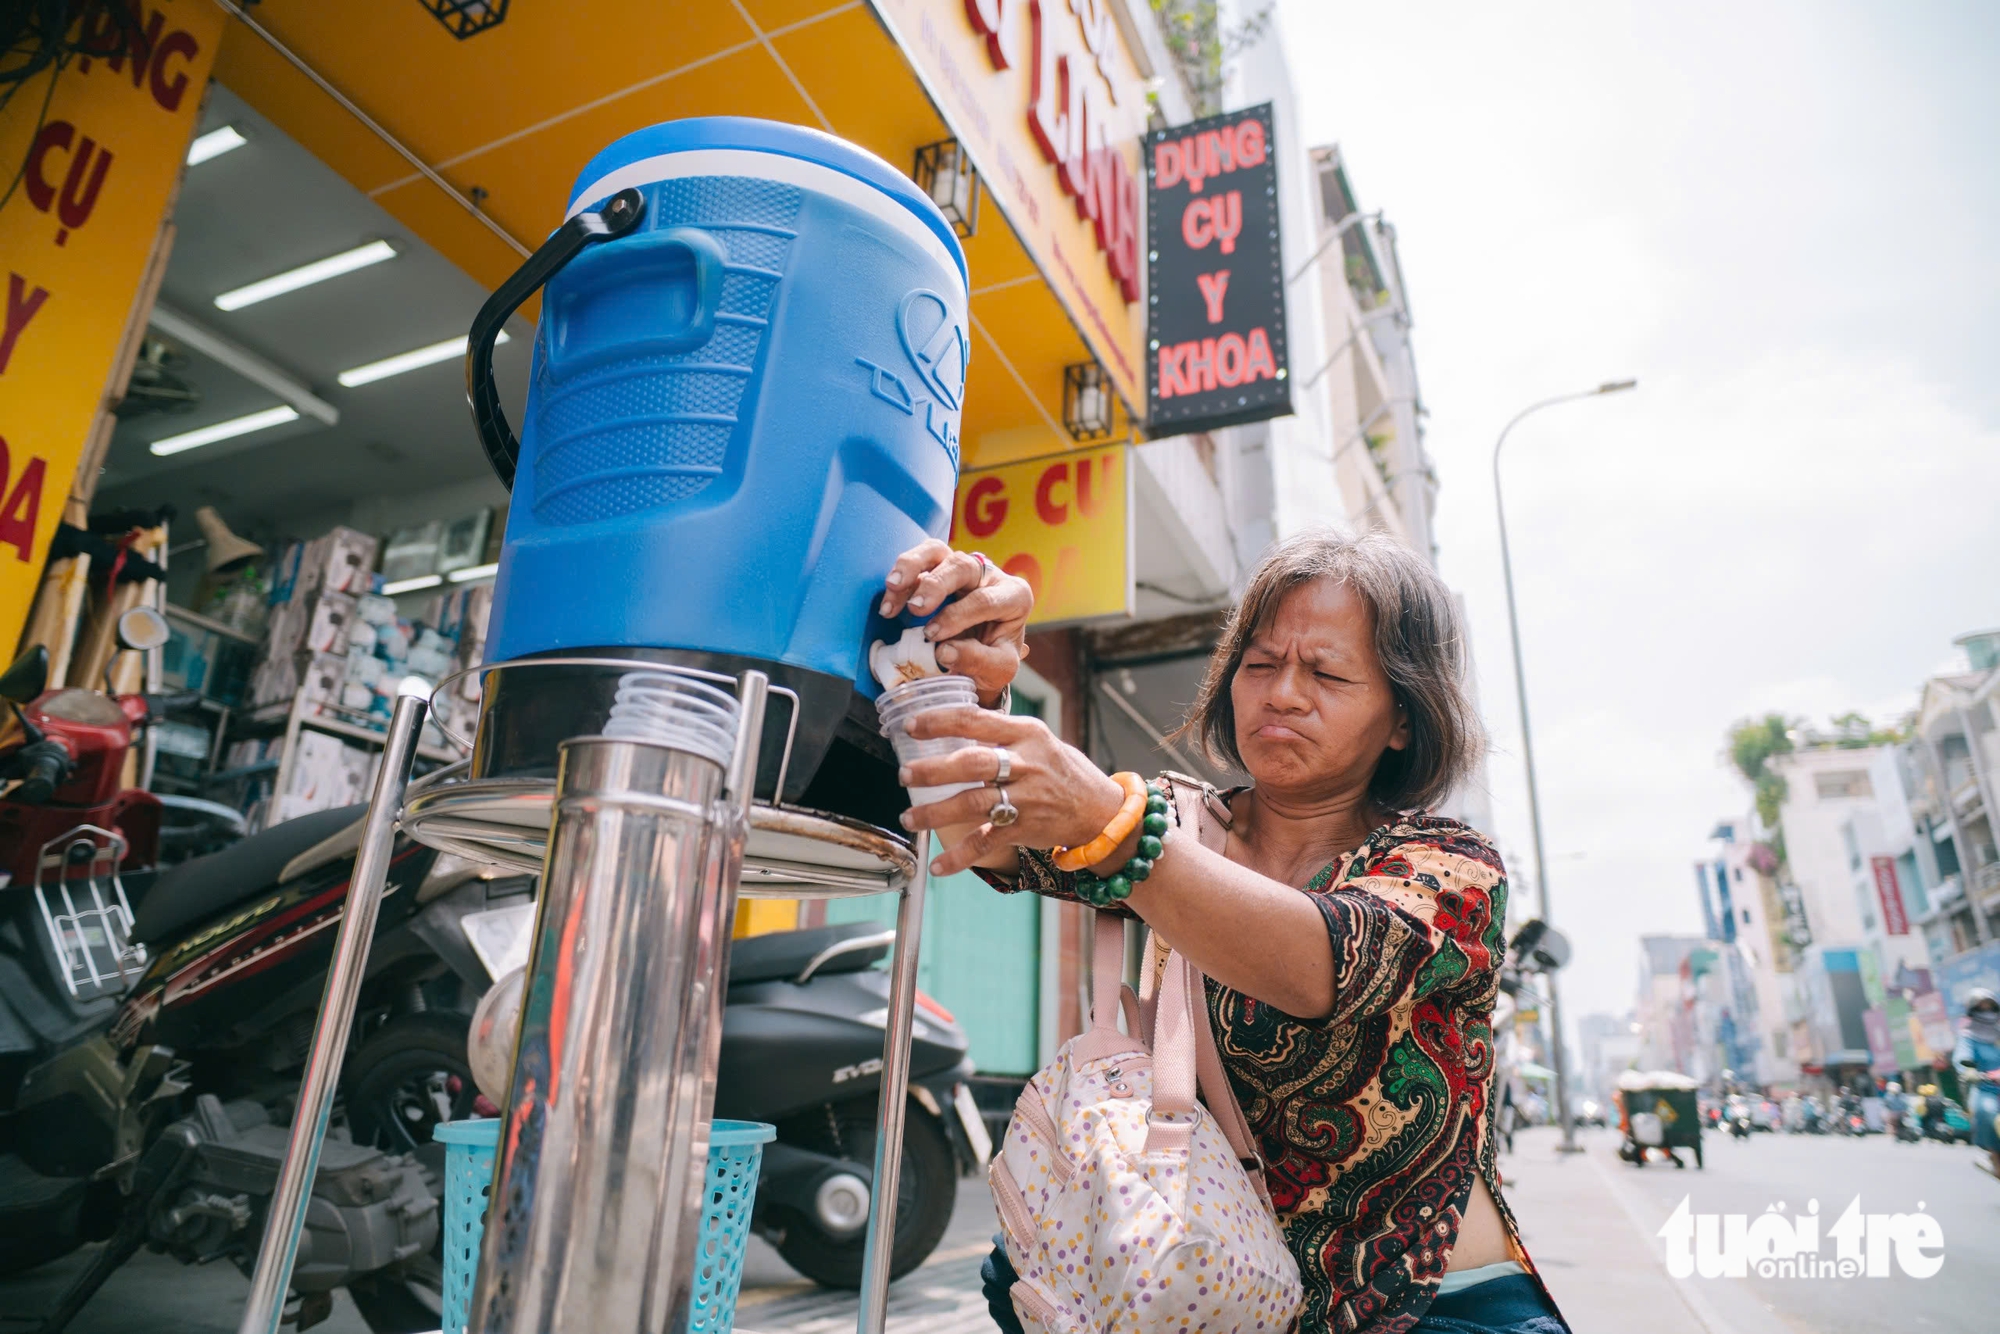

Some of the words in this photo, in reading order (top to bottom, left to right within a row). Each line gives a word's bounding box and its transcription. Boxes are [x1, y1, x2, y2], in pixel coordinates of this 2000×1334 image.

[25, 120, 114, 247] CỤ
[1155, 119, 1266, 193] DỤNG
[1182, 190, 1242, 254] CỤ
[0, 271, 50, 375] Y
[1197, 269, 1231, 323] Y
[1158, 327, 1277, 398] KHOA
[0, 434, 48, 563] A
